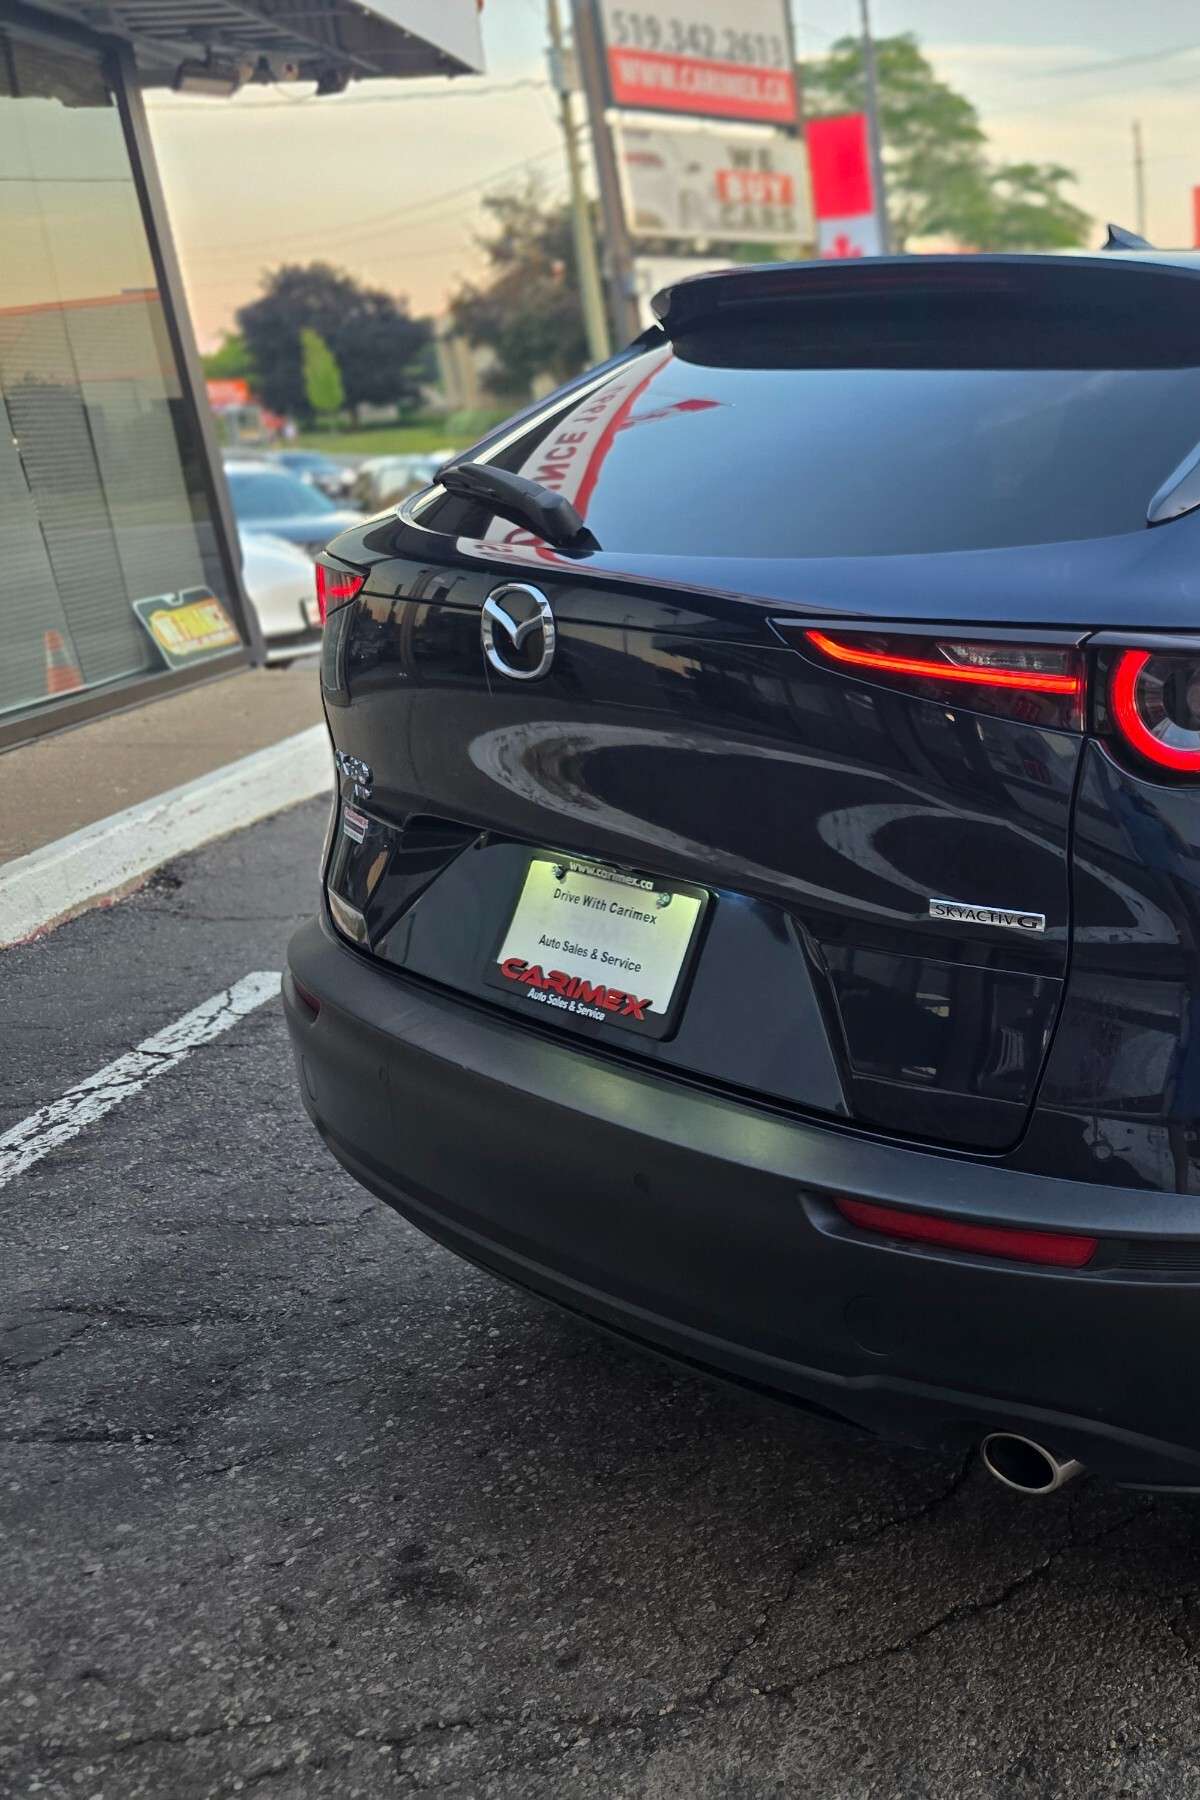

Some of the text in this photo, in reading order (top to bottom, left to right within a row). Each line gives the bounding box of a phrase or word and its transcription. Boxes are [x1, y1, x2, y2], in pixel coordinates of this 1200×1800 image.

[726, 175, 784, 204] BUY
[569, 861, 654, 890] www.carimex.ca
[553, 888, 657, 924] Drive With Carimex
[935, 904, 1014, 925] SKYACTIV
[538, 934, 642, 972] Auto Sales & Service
[501, 958, 652, 1020] CARIMEX
[527, 988, 605, 1021] Auto Sales & Service
